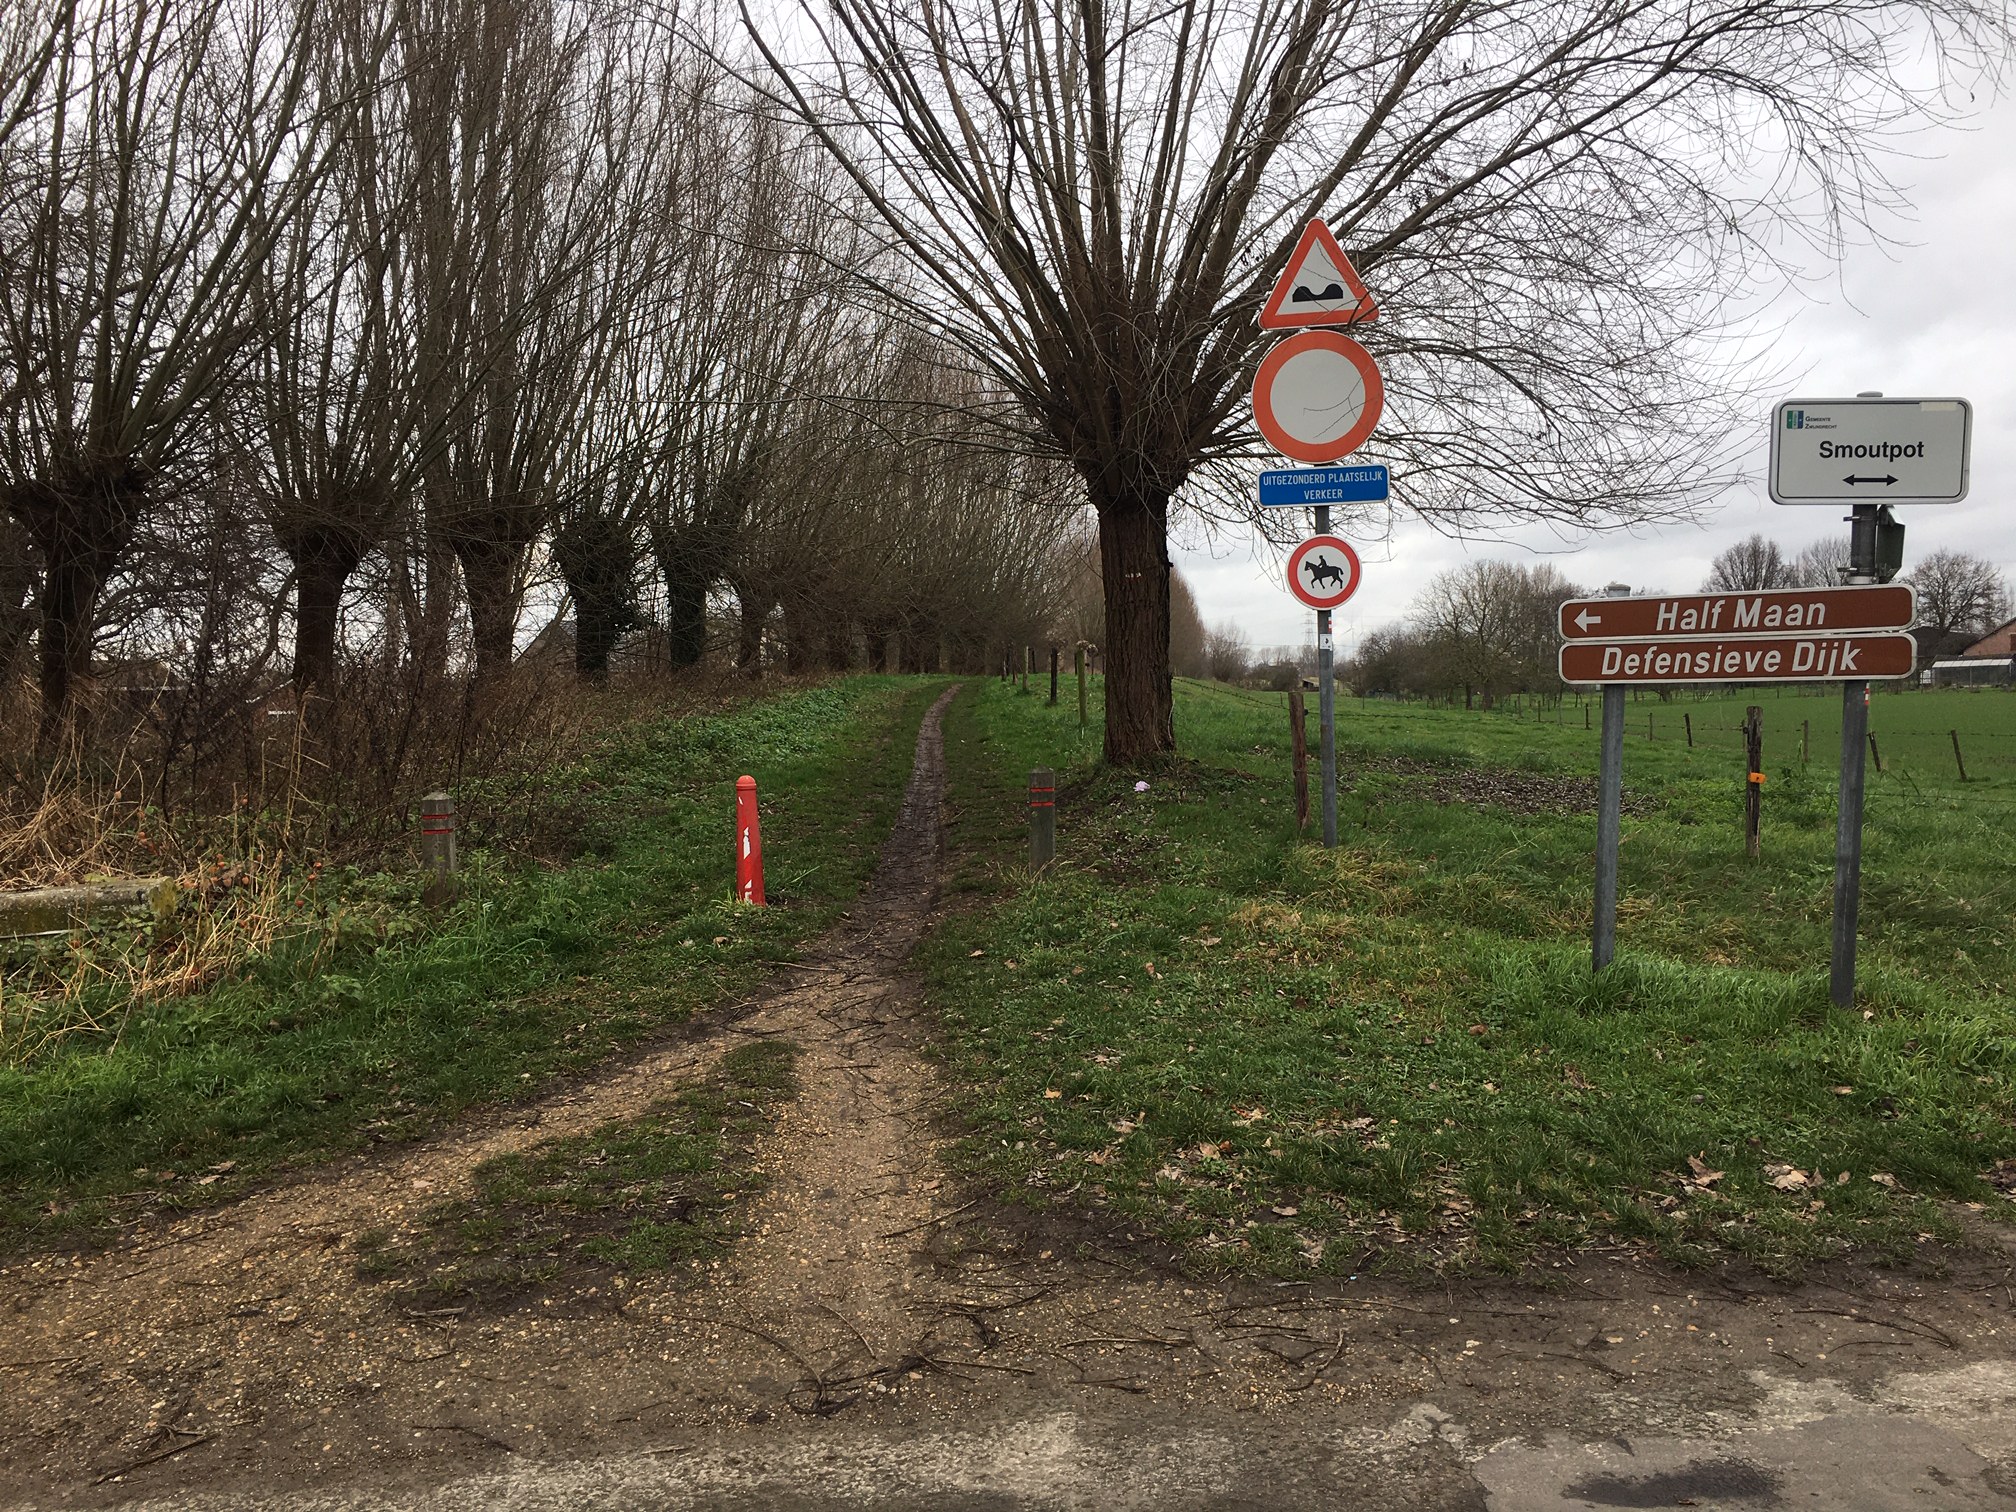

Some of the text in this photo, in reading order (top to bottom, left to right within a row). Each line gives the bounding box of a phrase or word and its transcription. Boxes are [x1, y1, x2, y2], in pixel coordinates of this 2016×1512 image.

[1819, 440, 1925, 463] Smoutpot
[1263, 471, 1383, 486] UITGEZONDERD PLAATSELIJK
[1304, 489, 1343, 500] VERKEER
[1656, 598, 1827, 631] Half Maan
[1601, 640, 1862, 677] Defensieve Dijk
